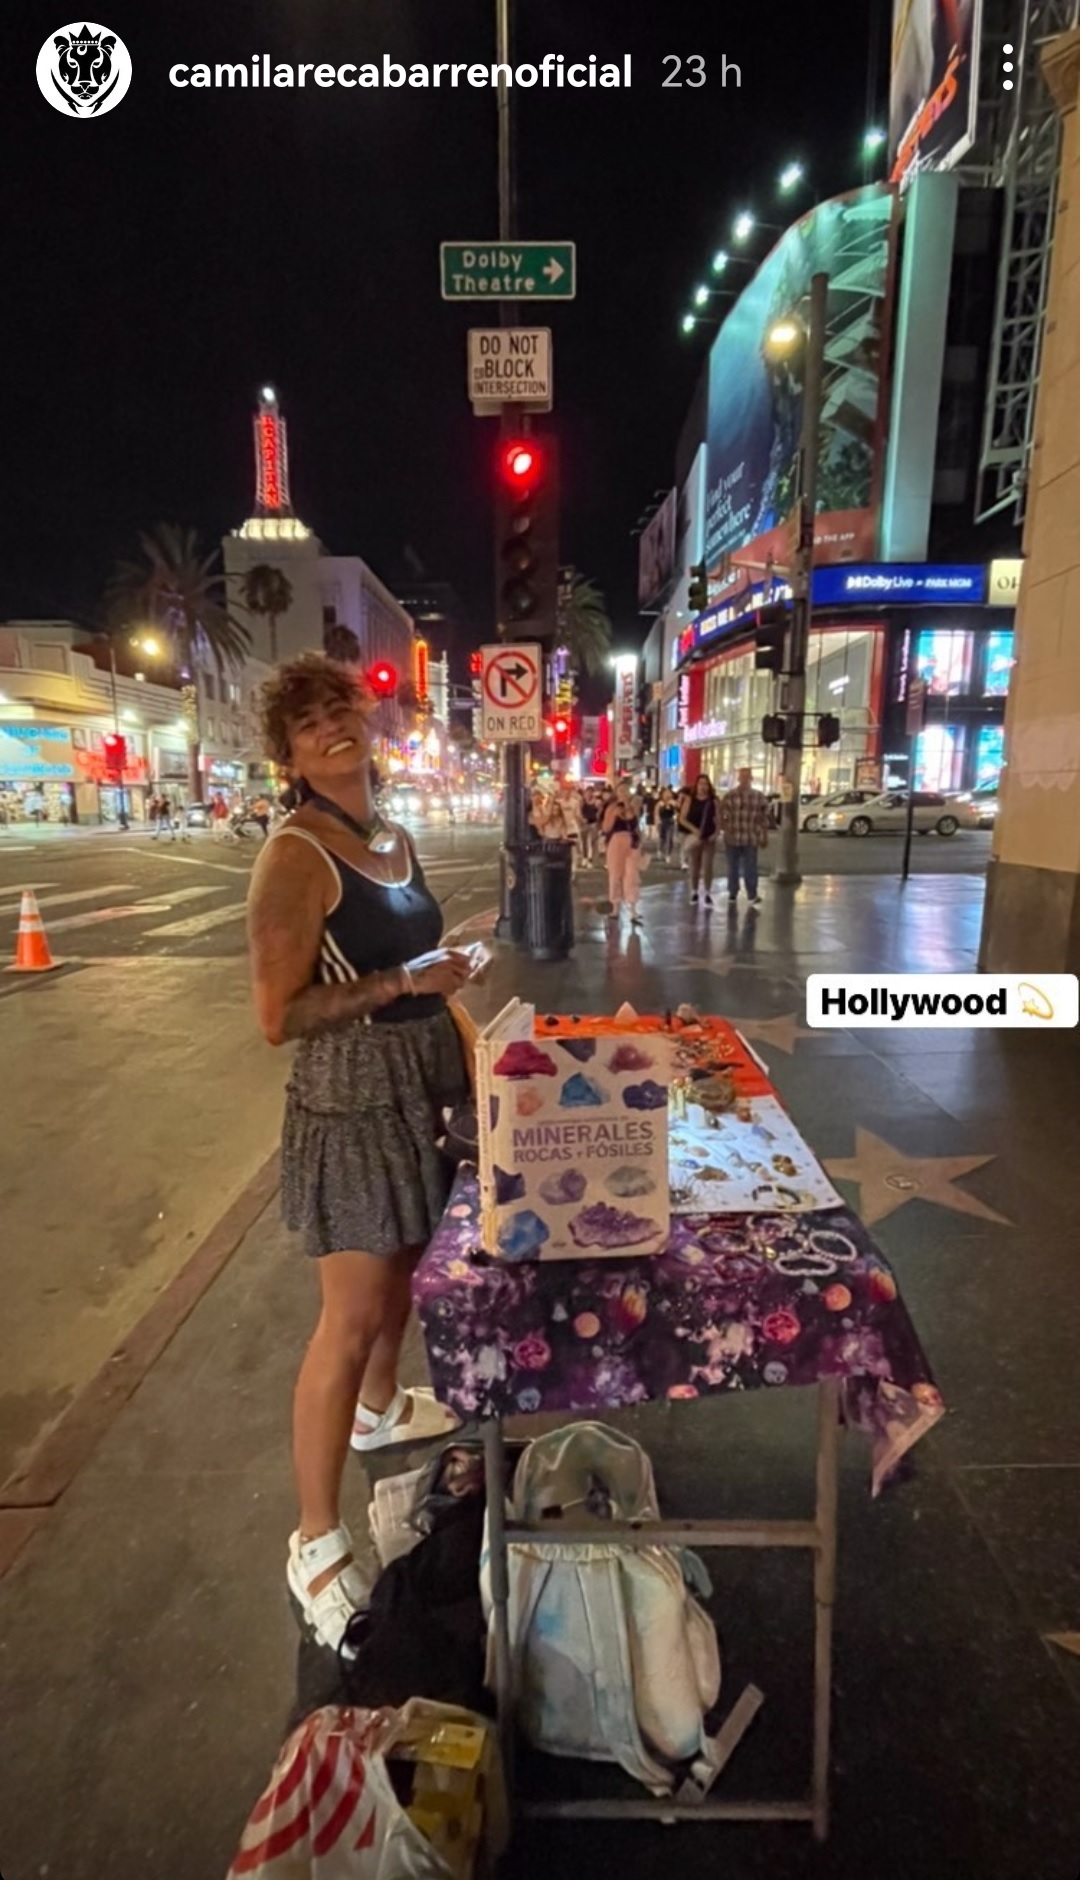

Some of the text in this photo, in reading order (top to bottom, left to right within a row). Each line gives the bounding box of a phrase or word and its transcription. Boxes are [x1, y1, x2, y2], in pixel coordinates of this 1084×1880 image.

[462, 250, 523, 272] Dolby
[452, 273, 536, 292] Theatre
[480, 335, 539, 355] DO NOT
[484, 358, 535, 378] BLOCK
[474, 381, 546, 395] INTERSECTION
[863, 575, 893, 591] Dolby
[486, 715, 536, 732] ON RED
[513, 1147, 573, 1163] ROCAS
[586, 1141, 654, 1159] FÓSILES
